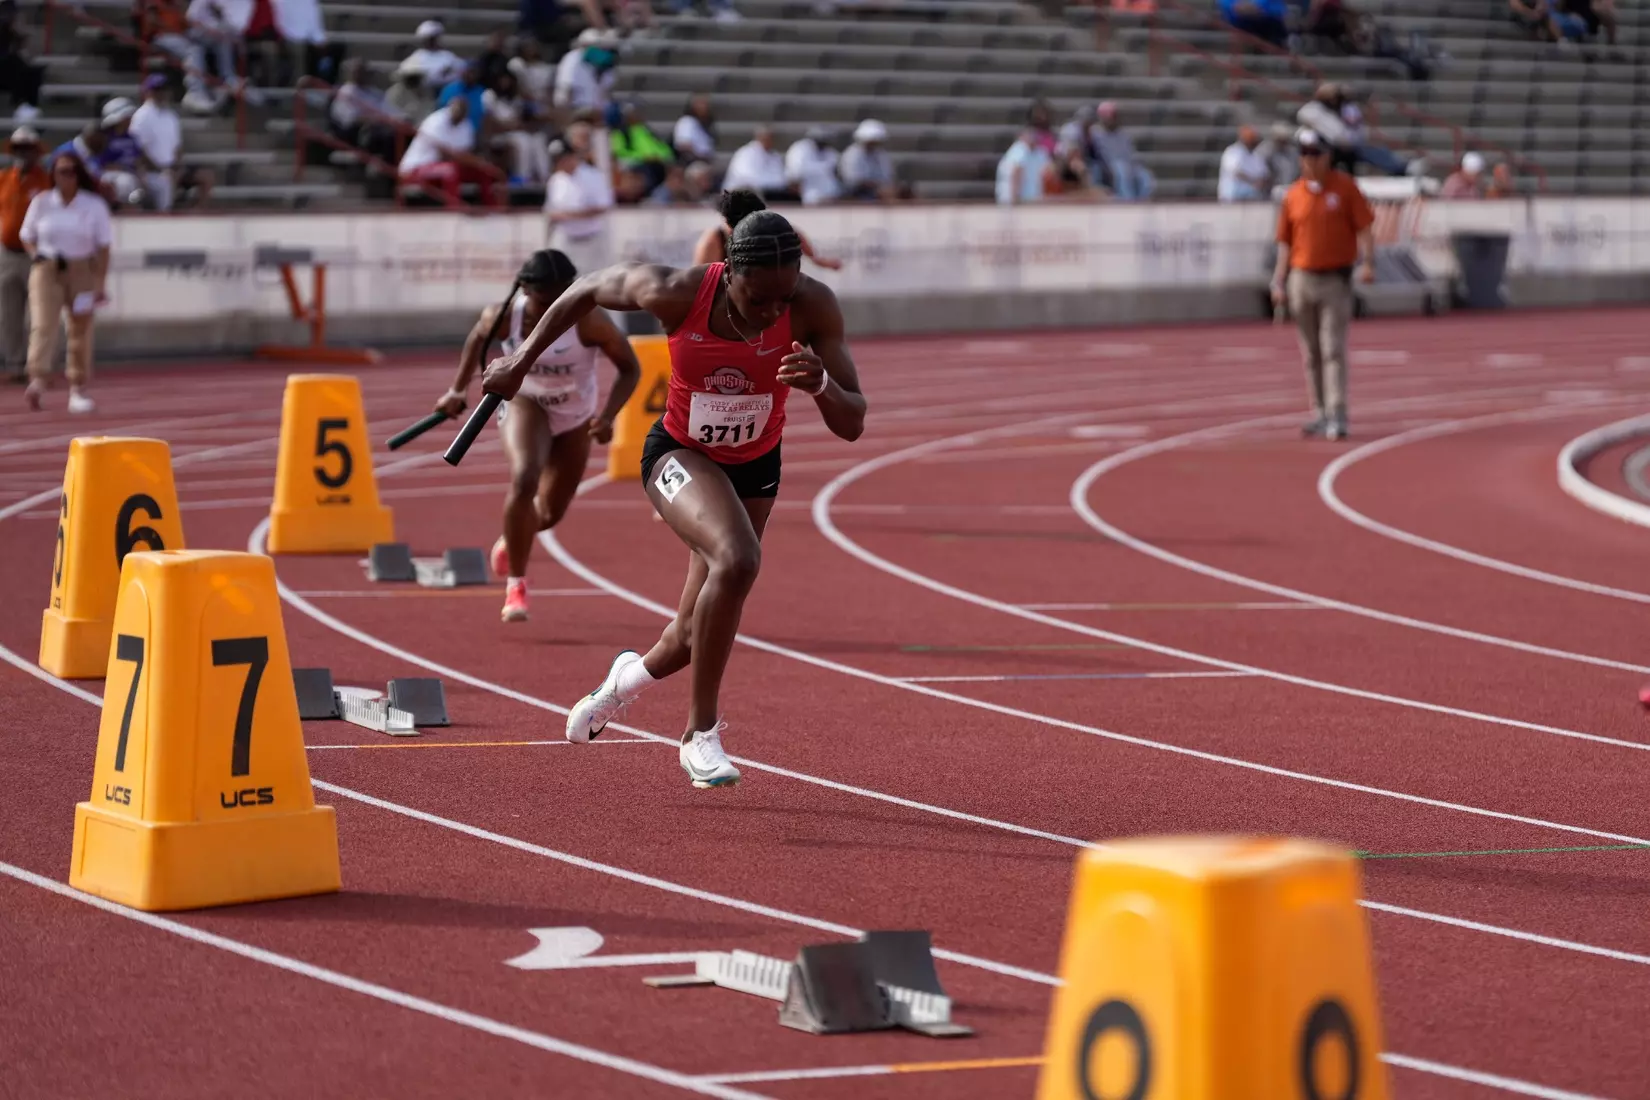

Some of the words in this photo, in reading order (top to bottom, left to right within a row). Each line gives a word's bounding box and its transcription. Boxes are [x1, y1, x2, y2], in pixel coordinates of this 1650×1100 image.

[710, 404, 738, 413] TEXAS
[738, 404, 770, 412] RELAYS
[314, 418, 353, 489] 5
[699, 422, 755, 444] 3711
[115, 493, 166, 575] 6
[115, 633, 145, 773] 7
[211, 636, 270, 778] 7
[105, 783, 132, 806] UCS
[220, 787, 275, 809] UCS
